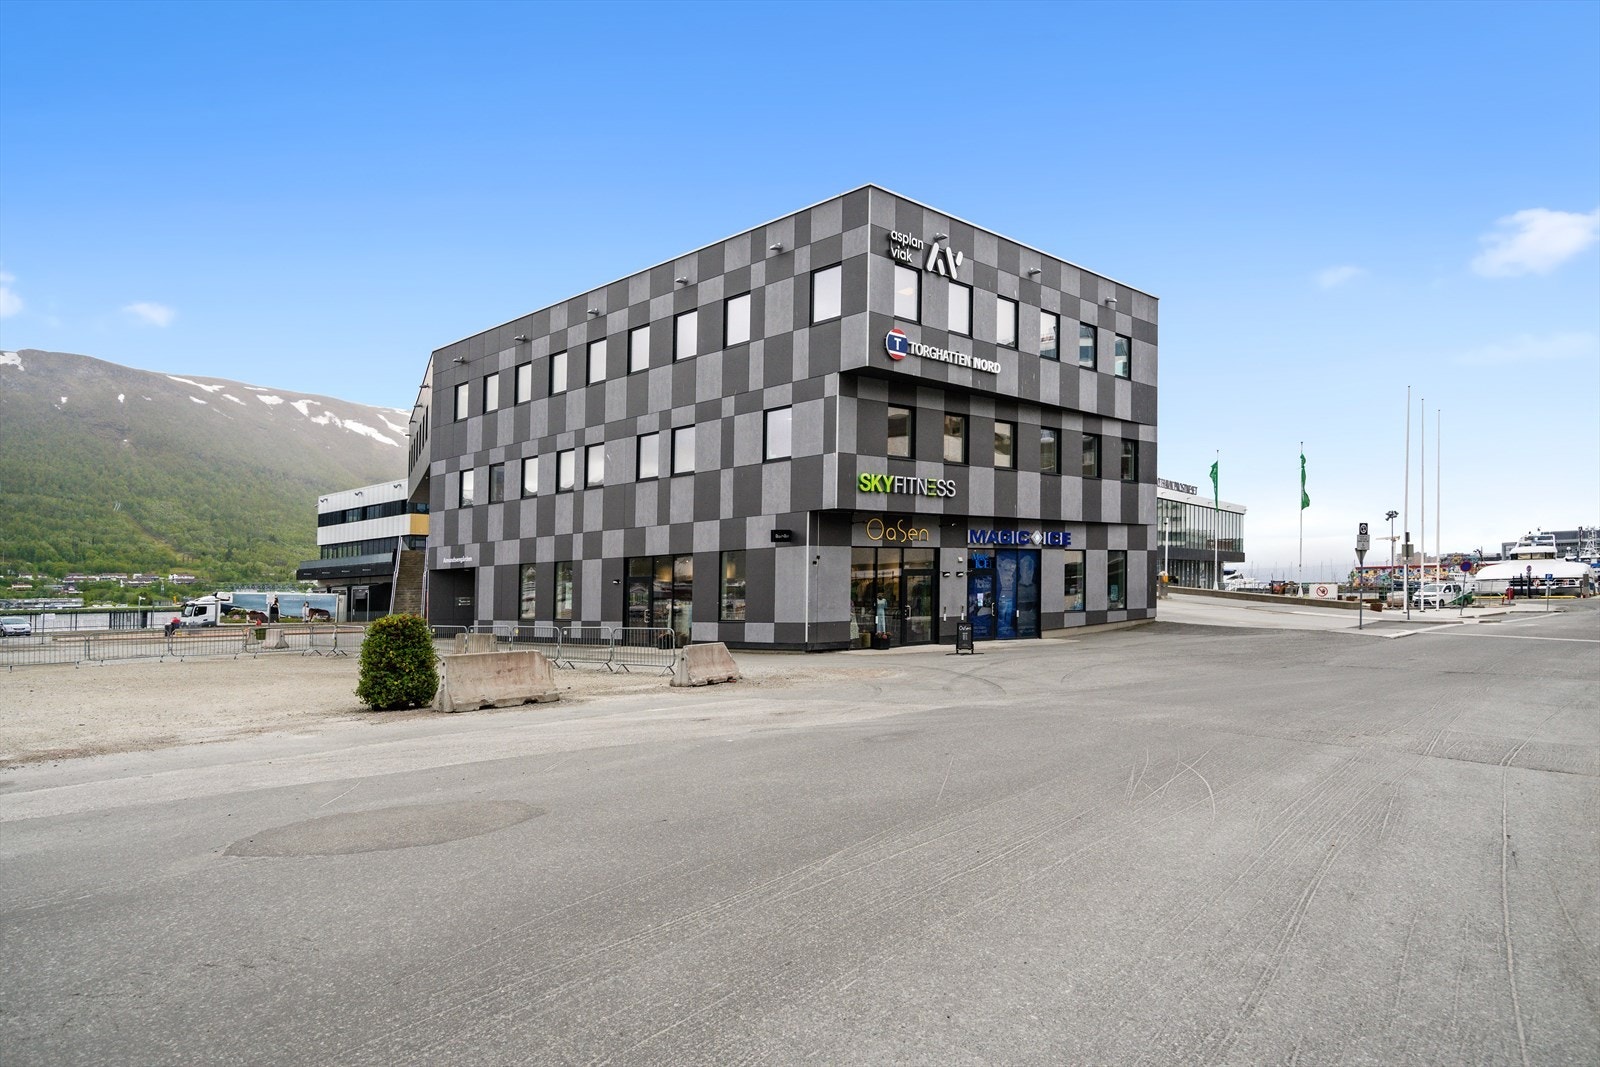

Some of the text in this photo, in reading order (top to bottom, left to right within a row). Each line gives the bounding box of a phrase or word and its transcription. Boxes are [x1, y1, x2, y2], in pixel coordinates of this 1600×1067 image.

[891, 230, 924, 250] asplan
[891, 246, 913, 262] viak
[894, 337, 902, 350] T
[909, 343, 1001, 373] TORGHATTEN NORD
[968, 529, 1072, 547] MAGIC ICE
